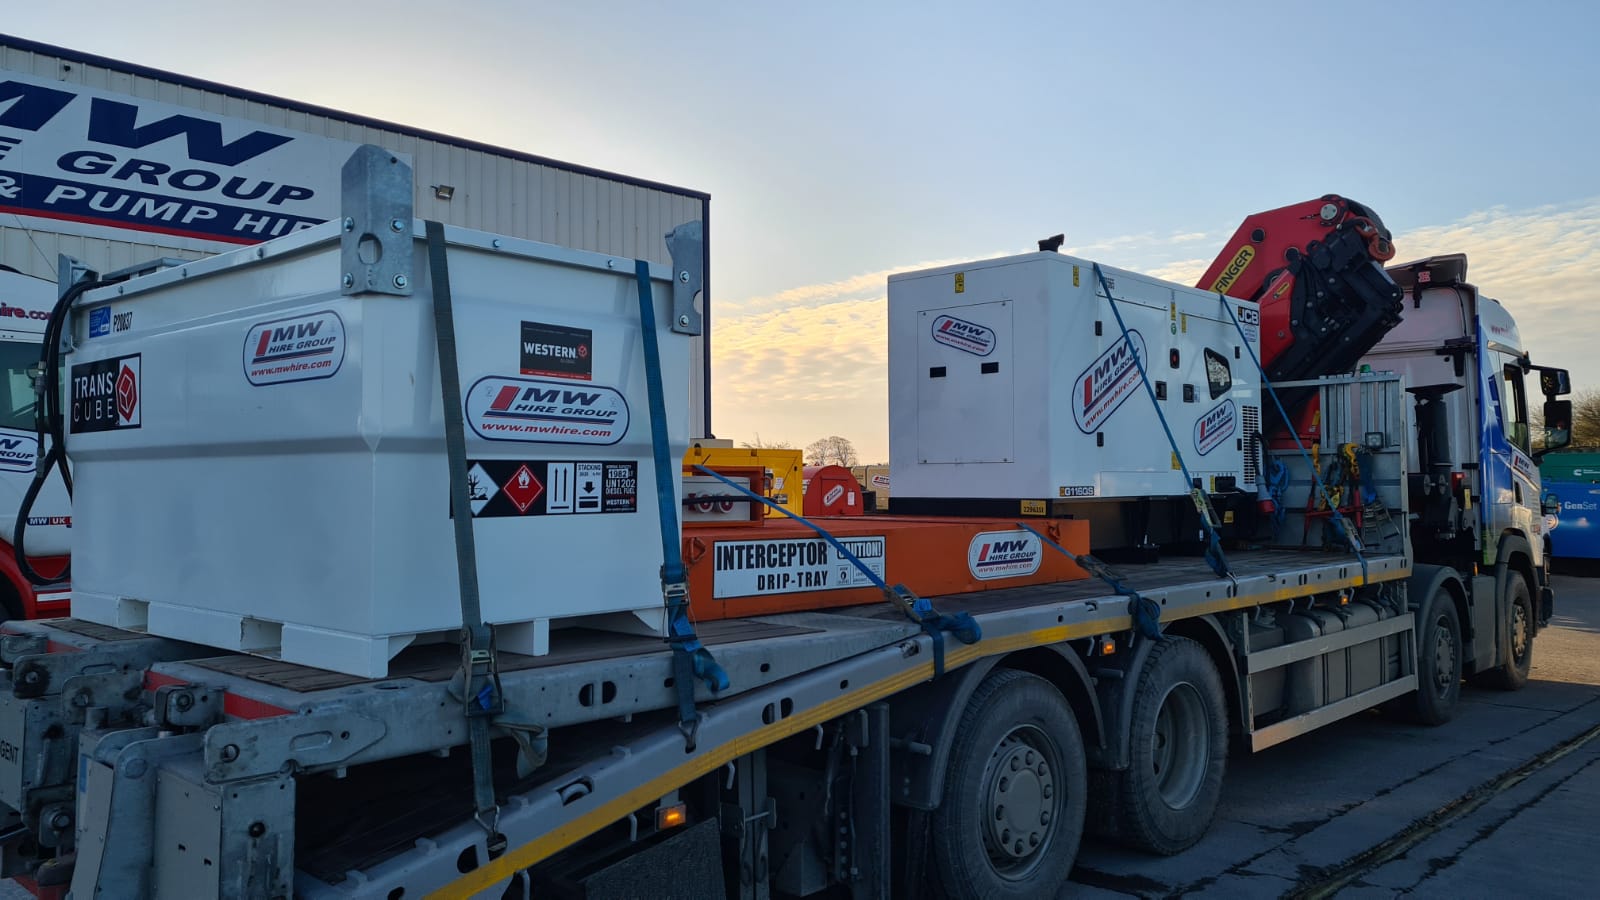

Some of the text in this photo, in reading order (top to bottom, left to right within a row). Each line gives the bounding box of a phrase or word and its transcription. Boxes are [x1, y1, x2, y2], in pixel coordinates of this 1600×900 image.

[57, 150, 314, 206] GROUP
[44, 184, 218, 224] PUMP
[1215, 250, 1252, 294] FINGER
[1238, 308, 1258, 325] JCB
[272, 320, 324, 342] MW
[952, 322, 985, 336] MW
[268, 336, 336, 354] HIRE GROUP
[524, 342, 576, 358] WESTERN
[251, 360, 332, 376] www.mwhire.com
[1094, 340, 1129, 384] MW
[74, 372, 113, 398] TRANS
[1095, 376, 1112, 396] HIRE
[521, 388, 602, 406] MW
[74, 398, 113, 422] CUBE
[514, 404, 618, 418] HIRE GROUP
[1207, 405, 1226, 426] MW
[482, 423, 612, 437] www.mwhire.com
[606, 479, 635, 488] UN1202
[1564, 502, 1597, 510] GenSet
[993, 540, 1028, 553] MW
[1010, 551, 1036, 560] GROUP
[716, 542, 827, 571] INTERCEPTOR
[757, 571, 828, 591] DRIP-TRAY
